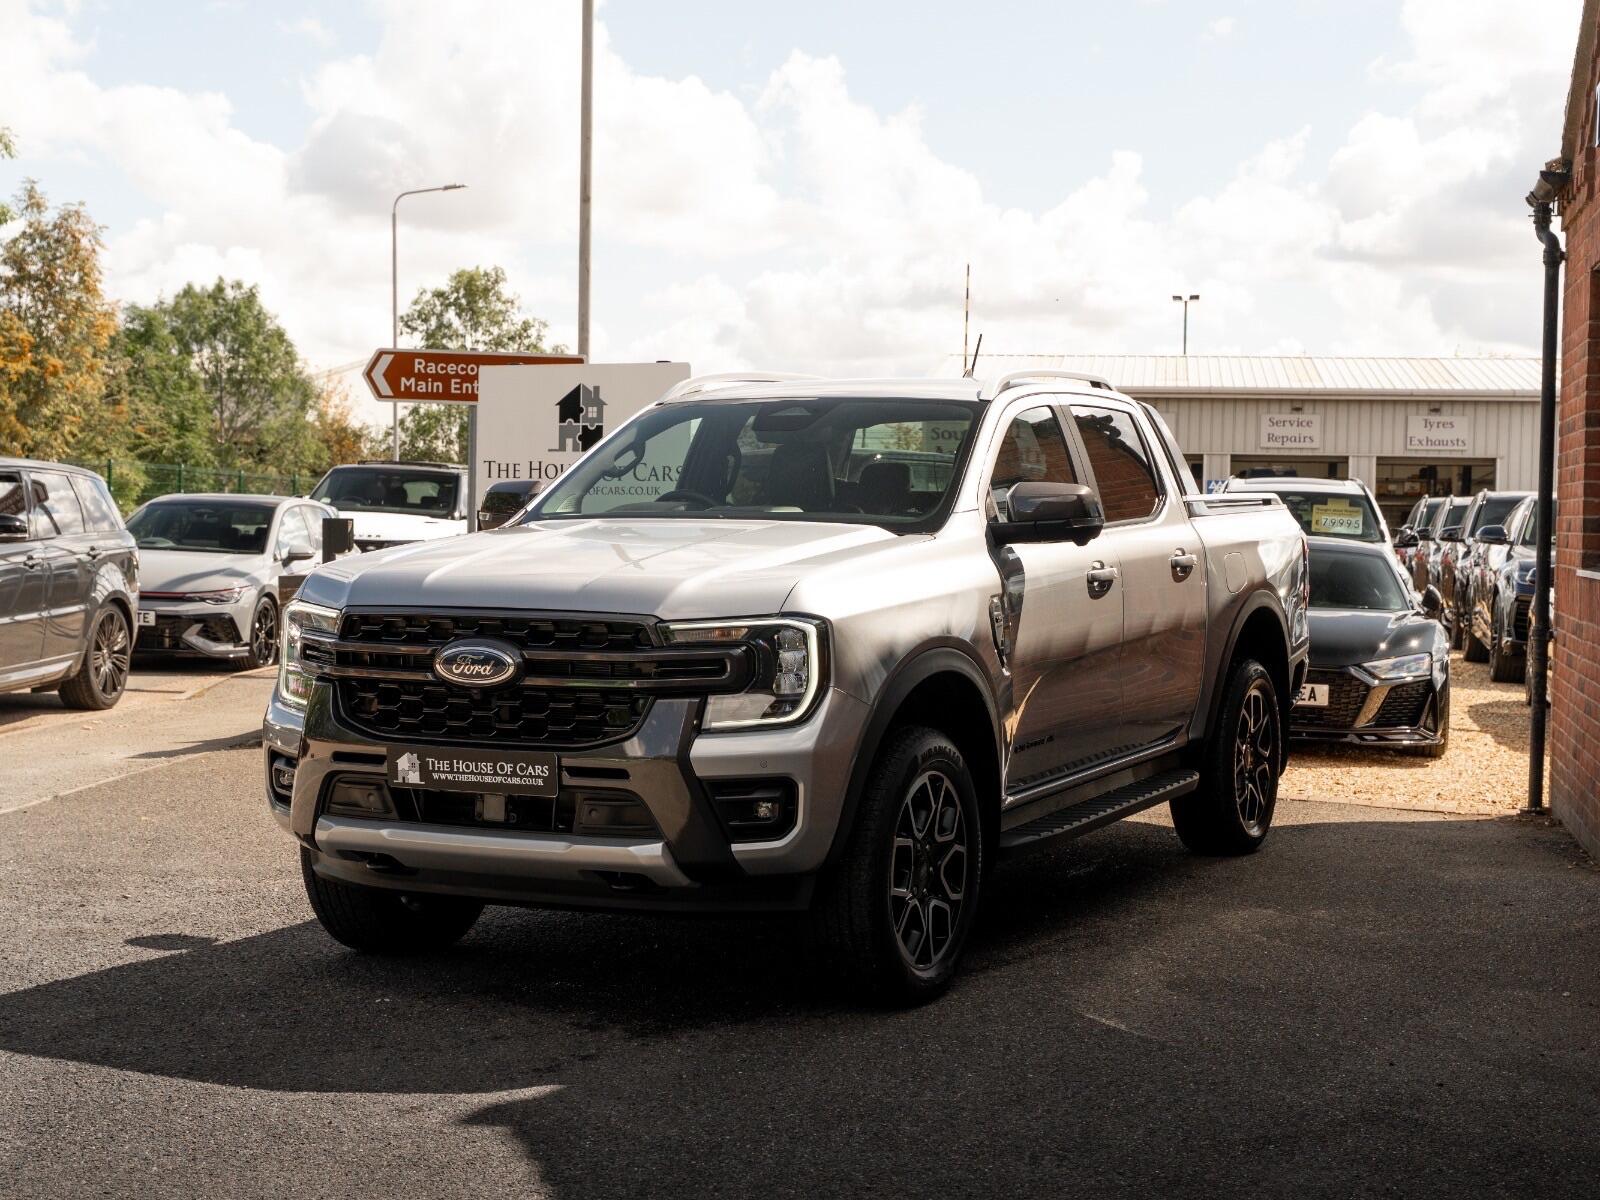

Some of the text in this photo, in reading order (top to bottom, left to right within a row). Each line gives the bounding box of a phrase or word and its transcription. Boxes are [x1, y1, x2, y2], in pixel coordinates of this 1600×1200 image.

[413, 357, 478, 375] Raceco
[400, 376, 443, 393] Main
[1268, 416, 1314, 429] Service
[1422, 418, 1455, 432] Tyres
[1266, 432, 1315, 446] Repairs
[1408, 435, 1467, 448] Exhausts
[483, 460, 521, 479] THE
[451, 653, 496, 677] Ford
[426, 757, 549, 777] THE HOUSE OF CARS
[432, 772, 544, 786] WWW.THEHOUSEOFCARS.CO.UK
